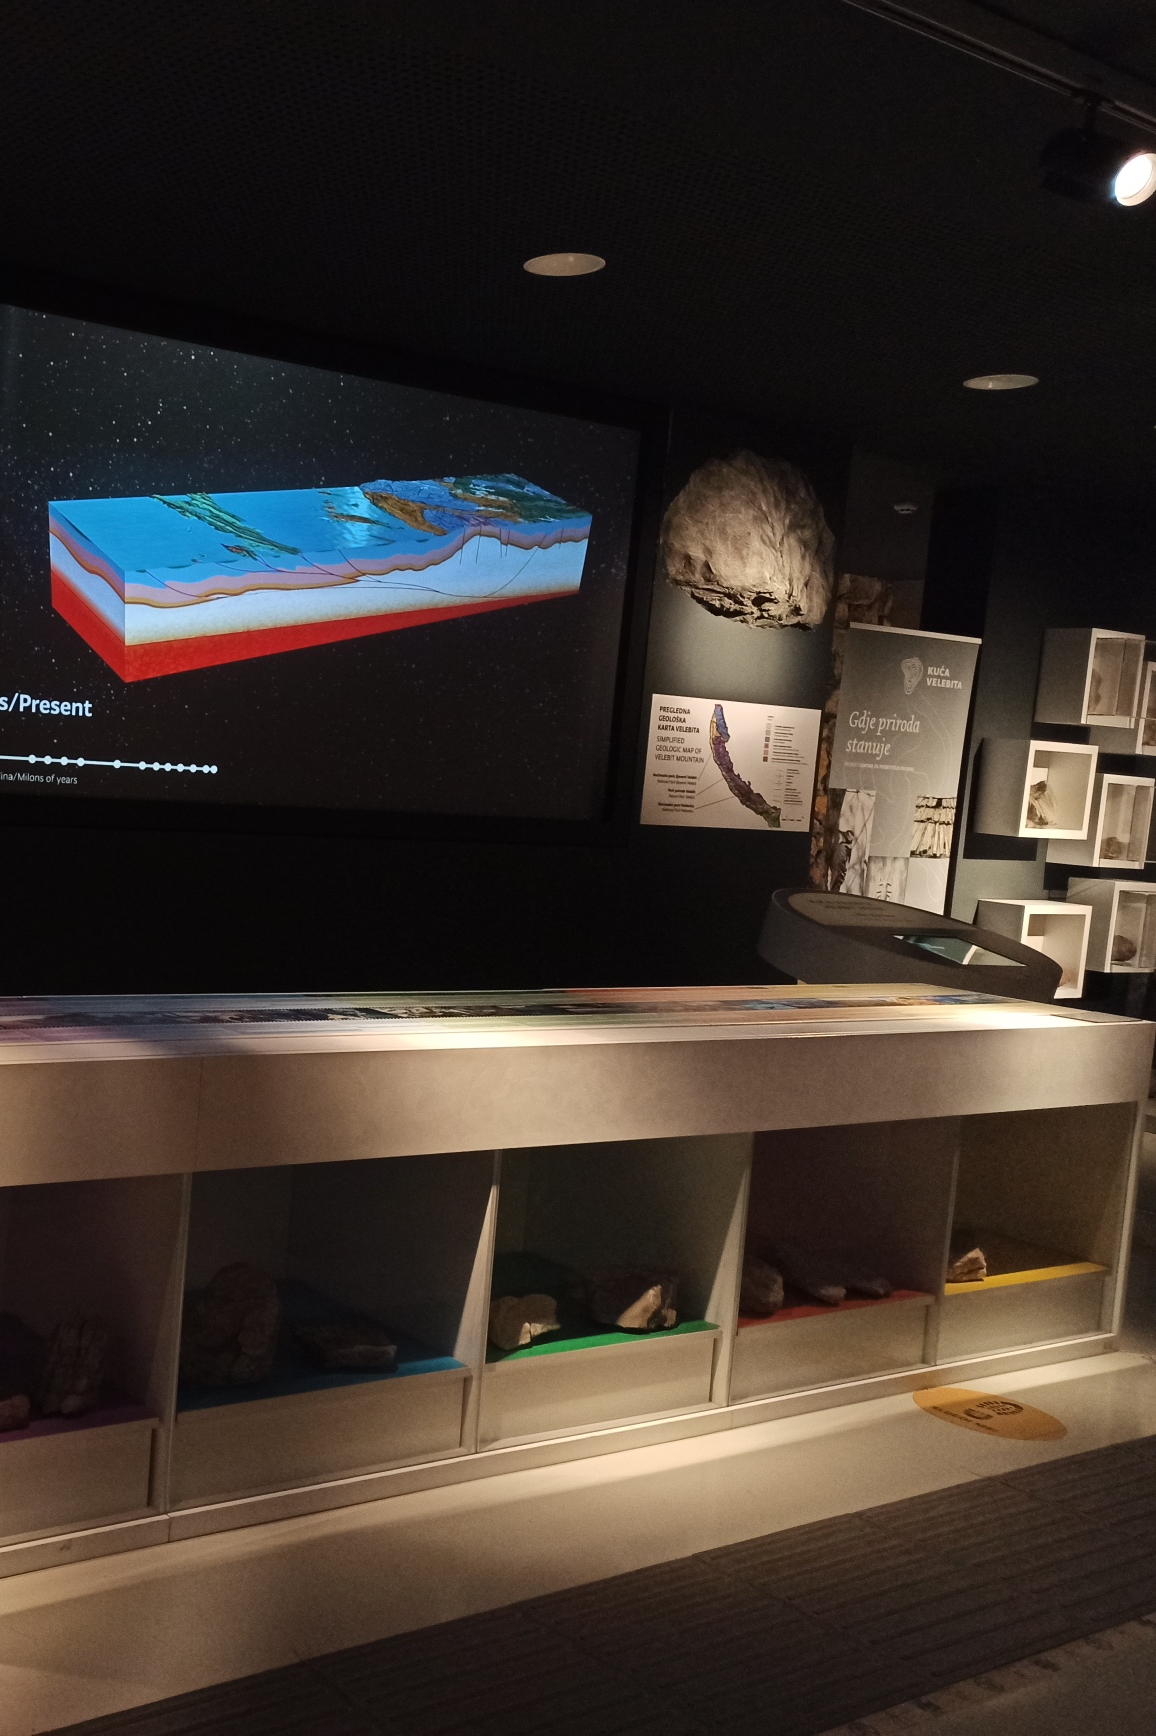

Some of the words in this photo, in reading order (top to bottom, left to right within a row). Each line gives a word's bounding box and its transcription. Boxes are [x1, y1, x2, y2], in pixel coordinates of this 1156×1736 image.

[927, 665, 950, 677] KUĆA
[926, 677, 963, 690] VELEBITA
[659, 705, 691, 715] PREGLEDNA
[658, 714, 686, 723] GEOLOŠKA
[849, 710, 876, 734] Gdje
[876, 713, 921, 736] priroda
[657, 723, 675, 732] KARTA
[675, 725, 700, 734] VELEBITA
[656, 735, 685, 745] SIMPLIFIED
[655, 744, 682, 753] GEOLOGIC
[845, 737, 891, 760] stanuje
[654, 753, 675, 761] VELEBIT
[676, 755, 704, 763] MOUNTAIN
[45, 773, 55, 783] of
[56, 775, 78, 785] years
